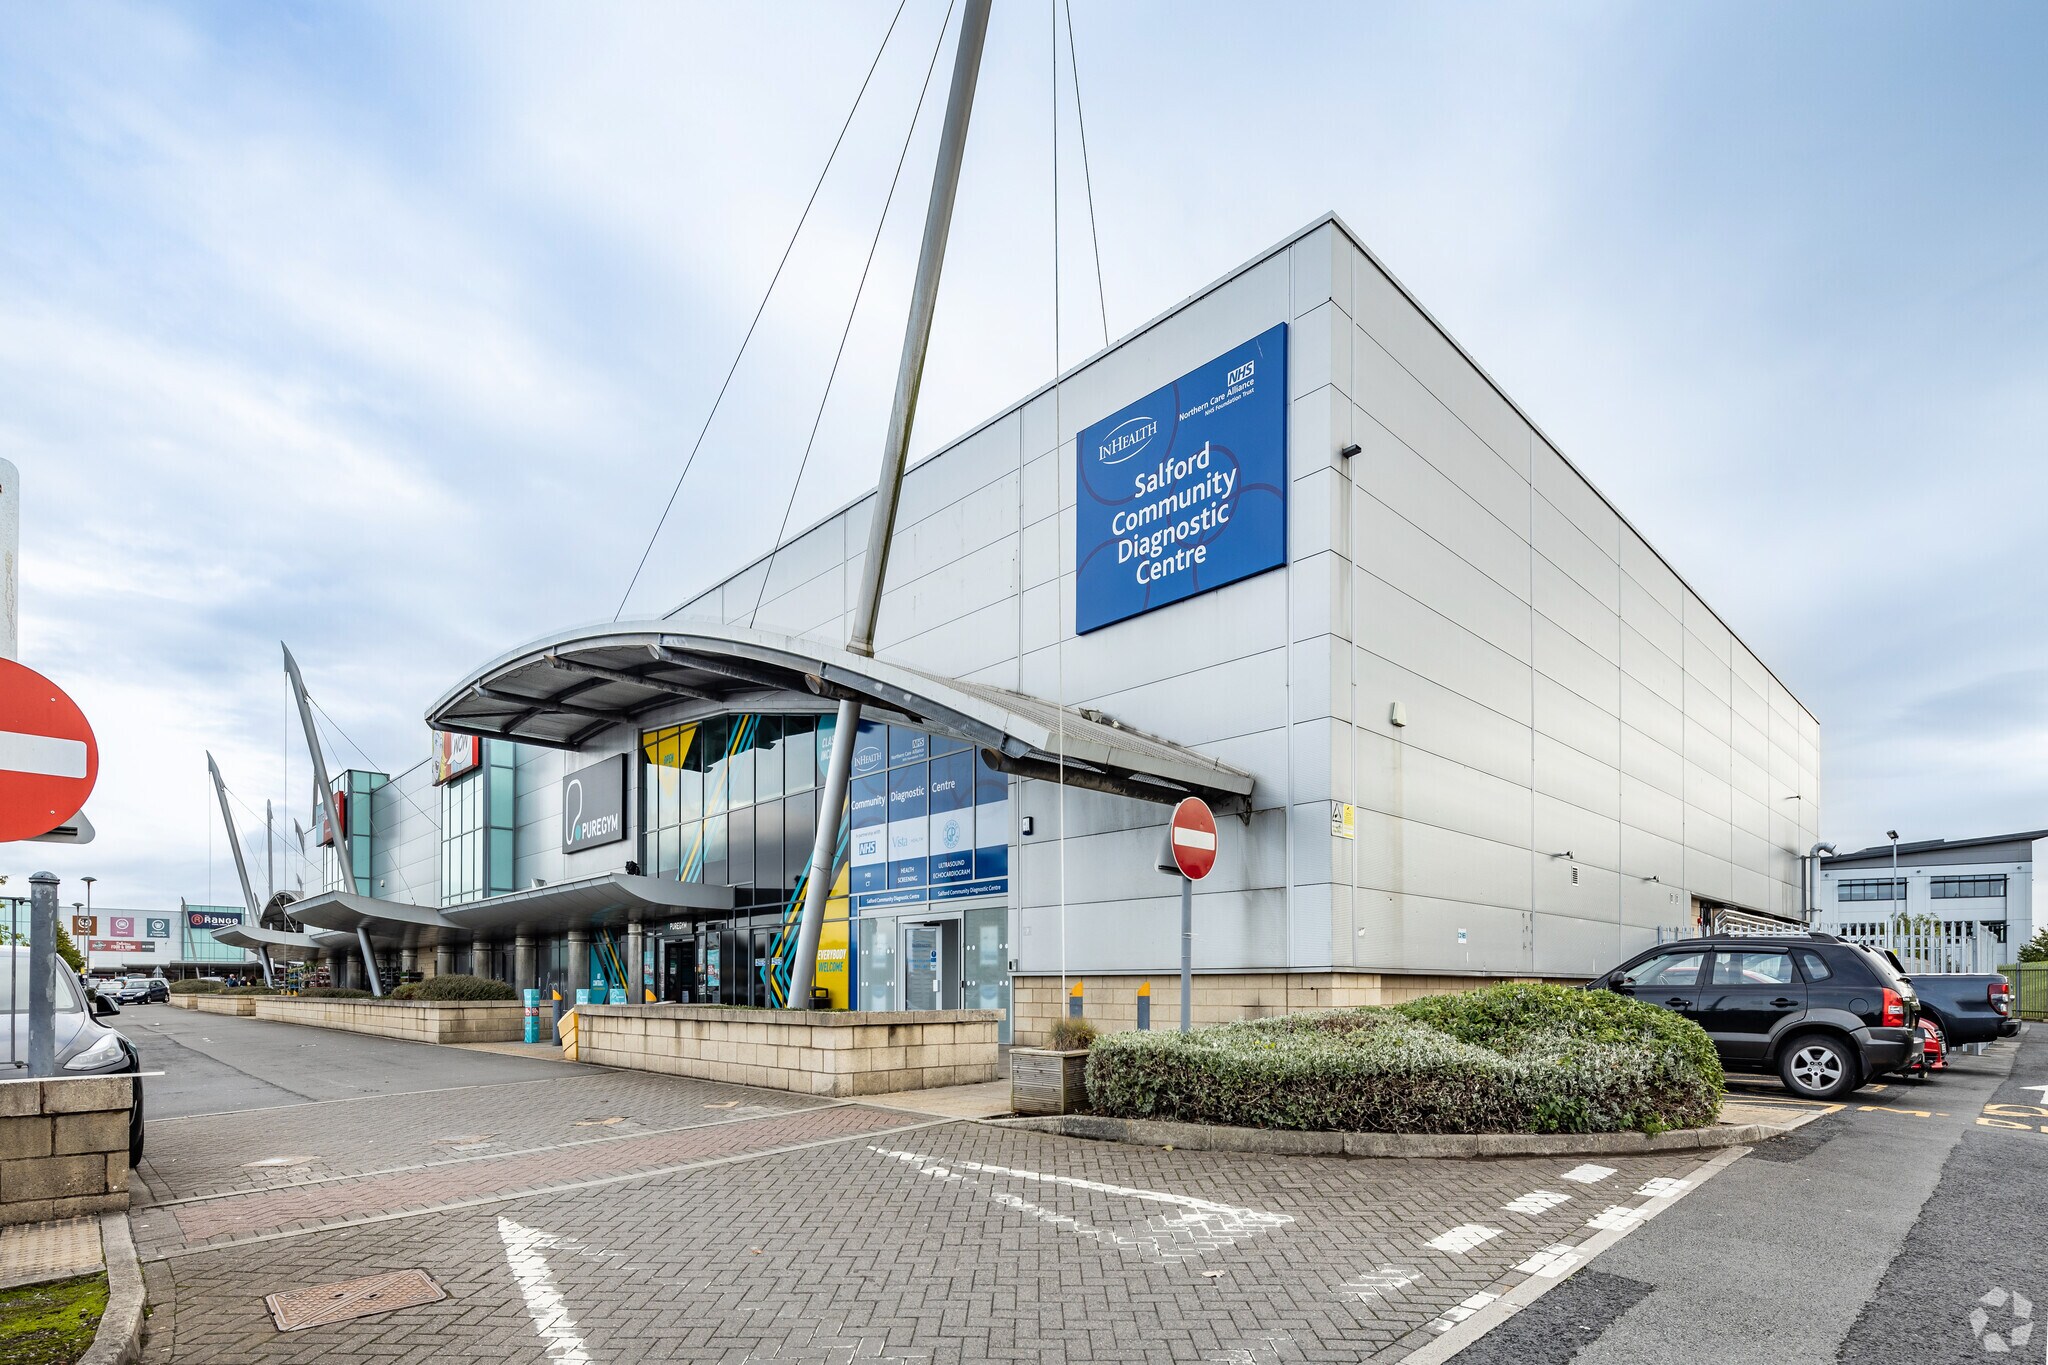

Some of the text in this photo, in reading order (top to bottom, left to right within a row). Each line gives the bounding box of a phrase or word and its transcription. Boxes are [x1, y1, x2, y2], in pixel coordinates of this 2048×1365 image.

[1229, 360, 1254, 385] NHS
[1179, 378, 1254, 421] Northern Care Alliance
[1204, 388, 1254, 416] NHS Foundation Trust
[1134, 441, 1209, 498] Salford
[1112, 467, 1237, 536] Community
[1118, 503, 1229, 564] Diagnostic
[1136, 544, 1206, 585] Centre
[912, 738, 924, 748] NHS
[932, 779, 955, 793] Centre
[852, 786, 924, 810] Community Diagnostic
[582, 814, 618, 840] PUREGYM
[859, 841, 876, 855] NHS
[892, 836, 908, 848] Vista
[938, 860, 965, 868] ULTRASOUND
[898, 875, 918, 883] SCREENING
[933, 869, 970, 879] ECHOCARDIOGRAM
[950, 888, 970, 896] Community
[970, 886, 988, 894] Diagnostic
[670, 922, 687, 930] PUREGYM
[818, 949, 847, 960] EVERYBODY
[818, 962, 844, 972] WELCOME
